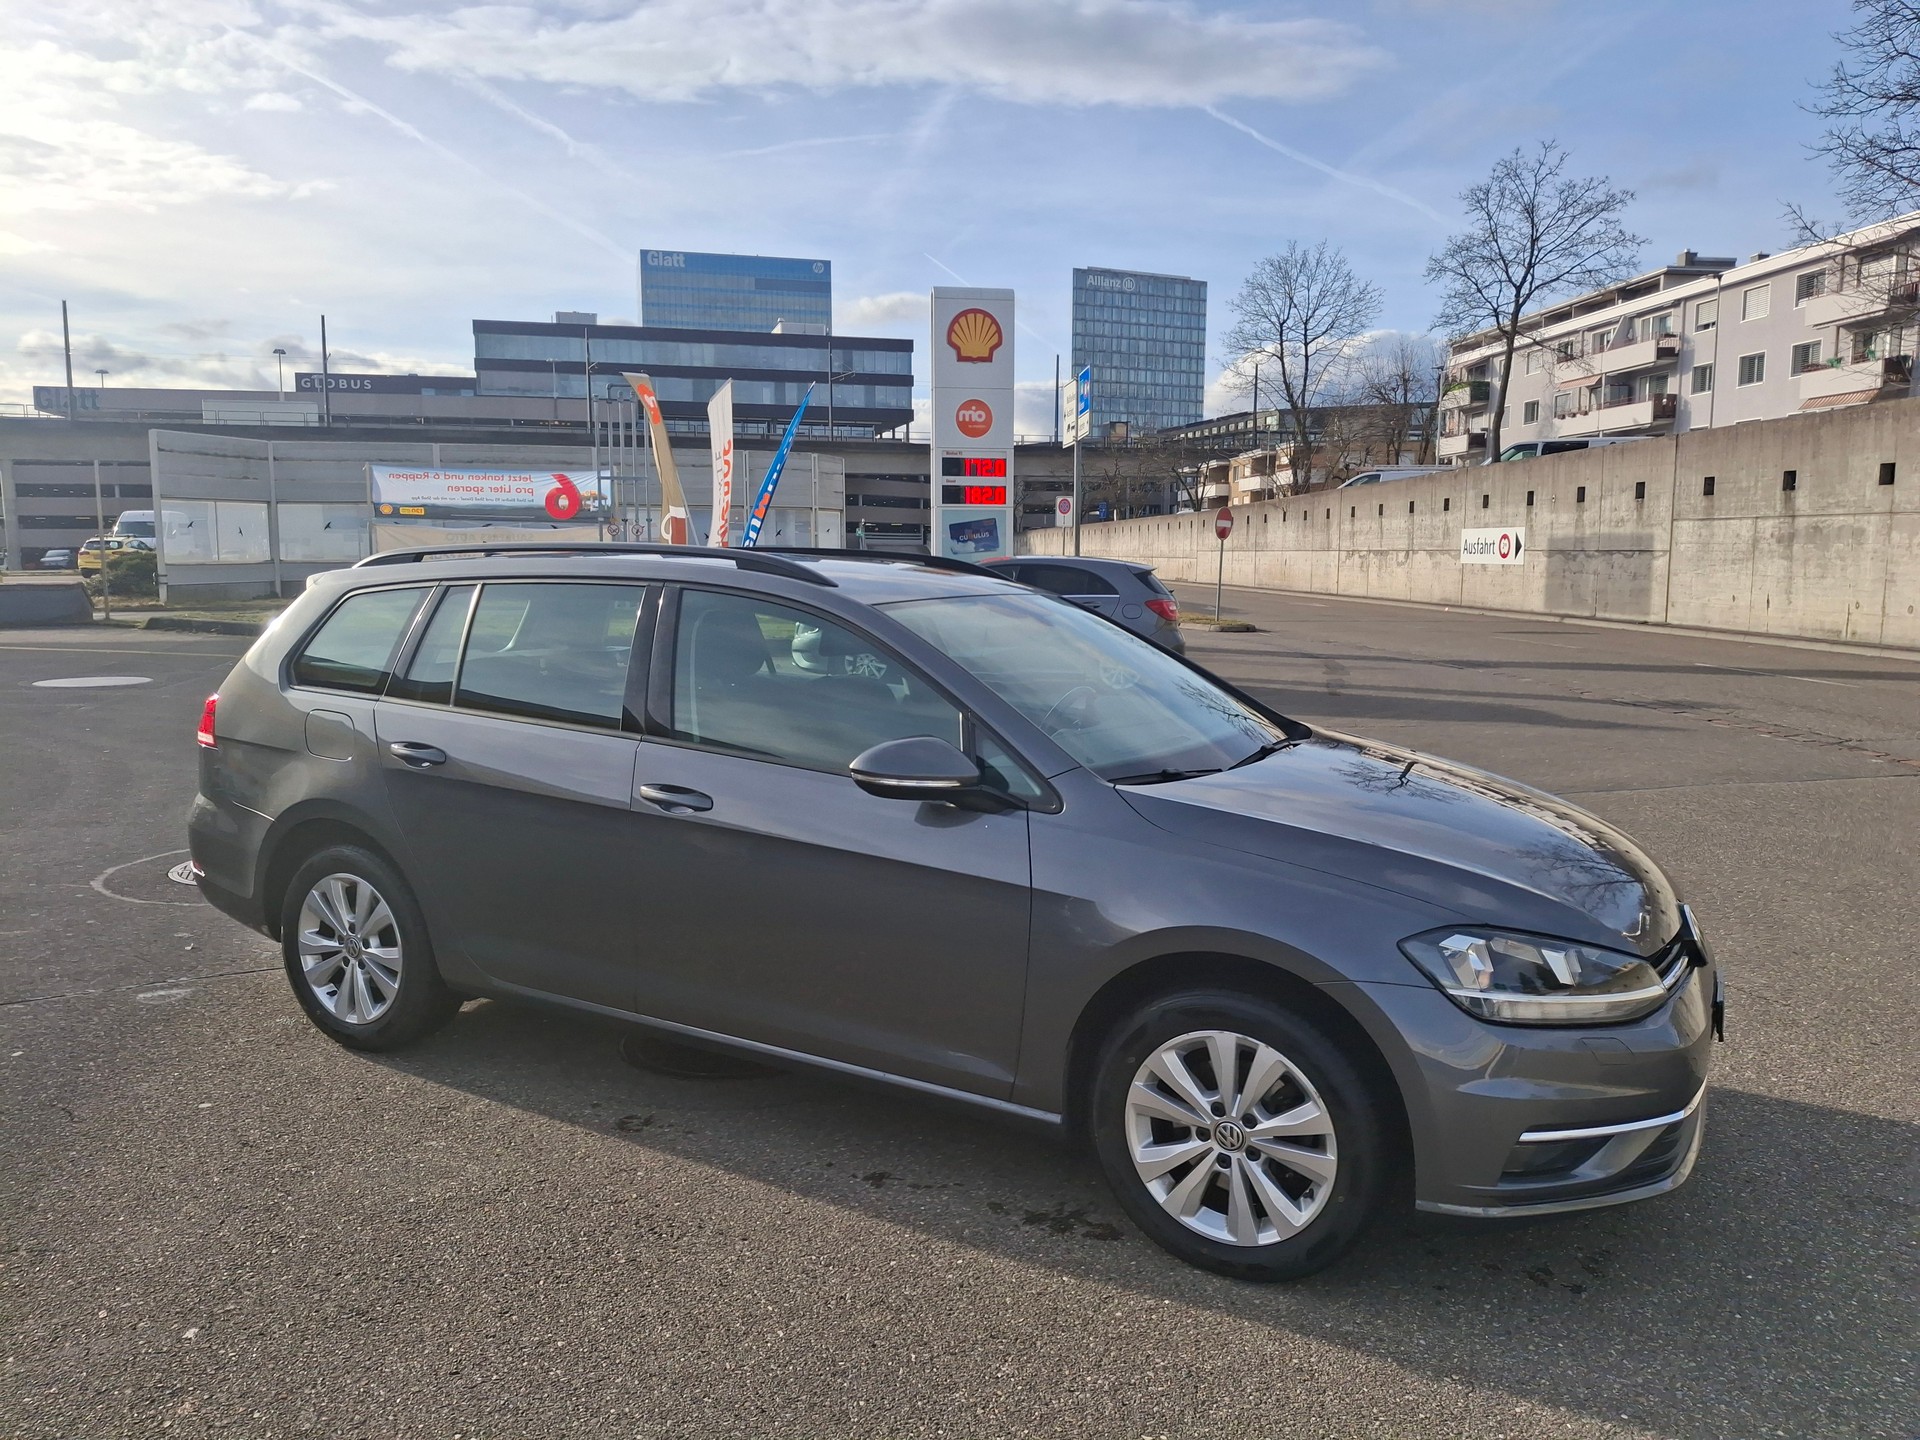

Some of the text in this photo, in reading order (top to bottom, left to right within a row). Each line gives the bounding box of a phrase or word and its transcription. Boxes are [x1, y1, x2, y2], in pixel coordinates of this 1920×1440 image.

[647, 251, 685, 267] Glatt
[1087, 275, 1120, 288] Allianz
[301, 378, 371, 389] GLOBUS
[36, 389, 101, 410] Glatt
[959, 406, 986, 422] mio
[1463, 537, 1496, 555] Ausfahrt
